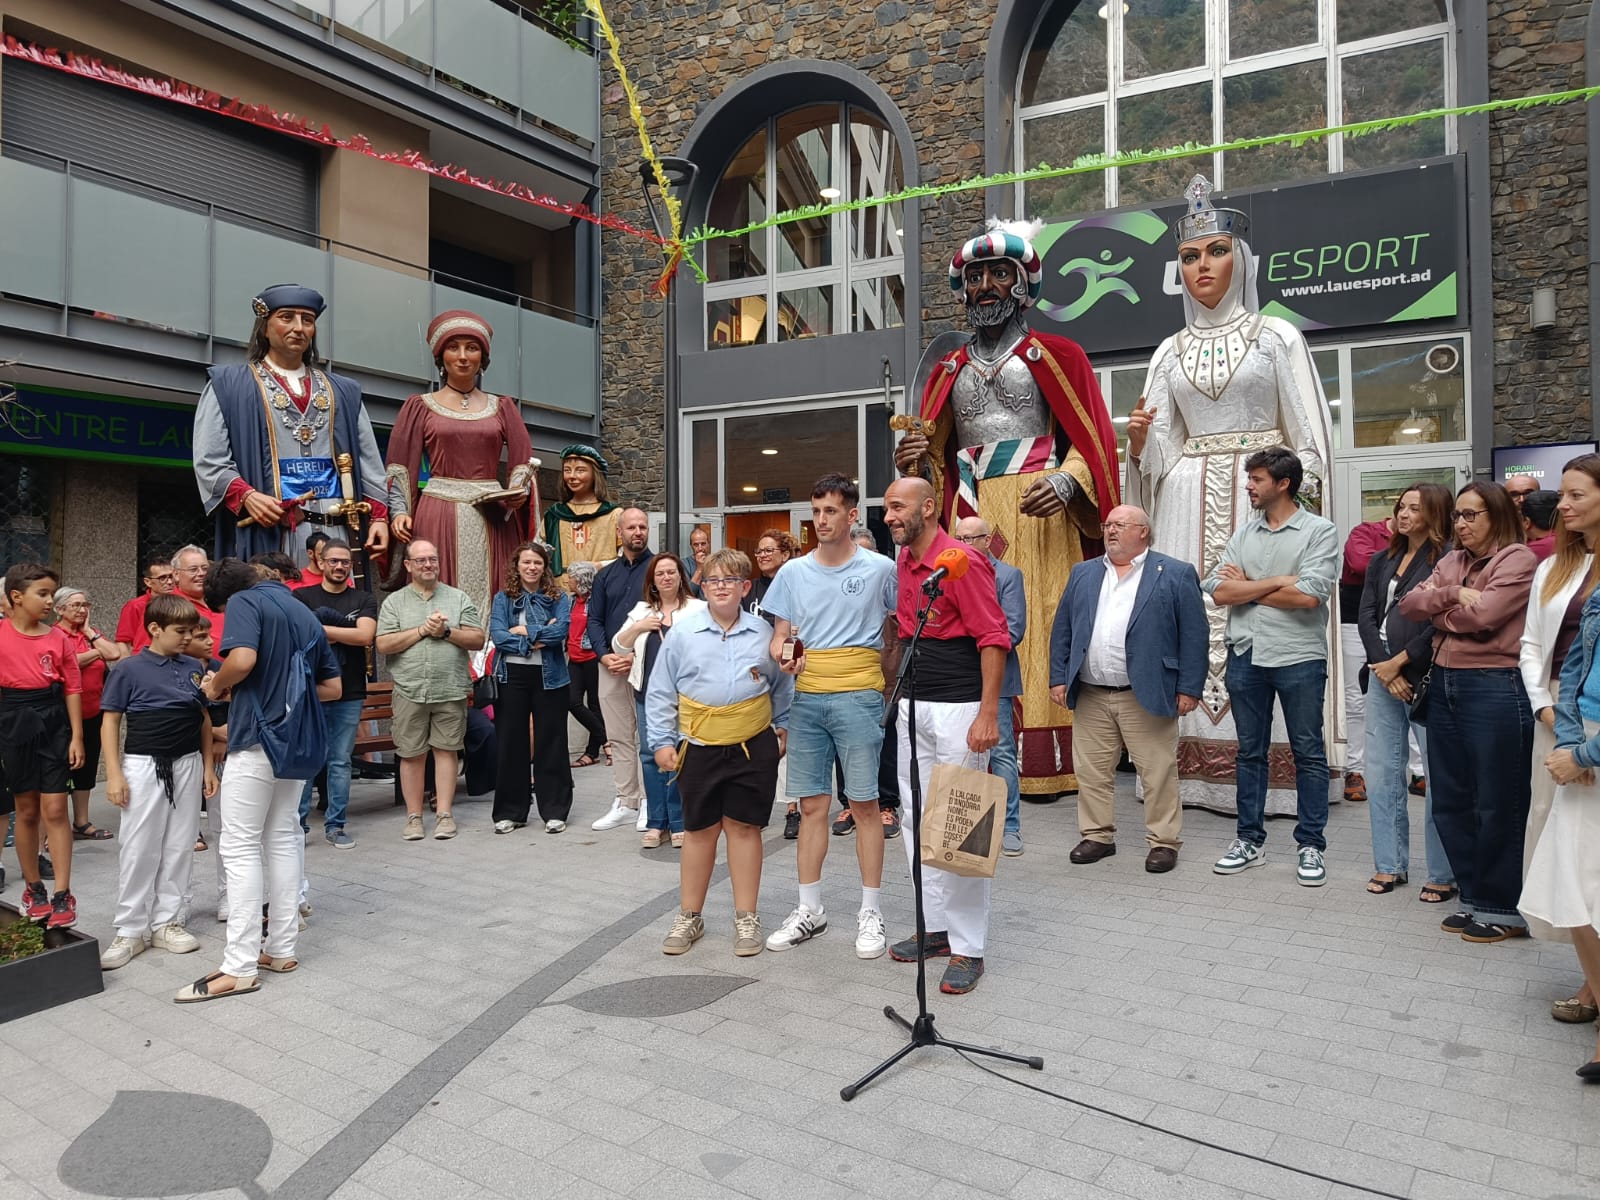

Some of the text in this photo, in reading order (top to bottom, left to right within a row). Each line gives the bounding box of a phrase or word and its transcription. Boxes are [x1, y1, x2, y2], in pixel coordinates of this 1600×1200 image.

[1268, 233, 1429, 281] ESPORT
[1281, 269, 1431, 297] www.lauesport.ad
[286, 461, 325, 474] HEREU
[1505, 464, 1535, 472] HORARI
[946, 814, 974, 827] ES PODEN
[945, 822, 968, 835] FER LES
[944, 831, 963, 842] COSES
